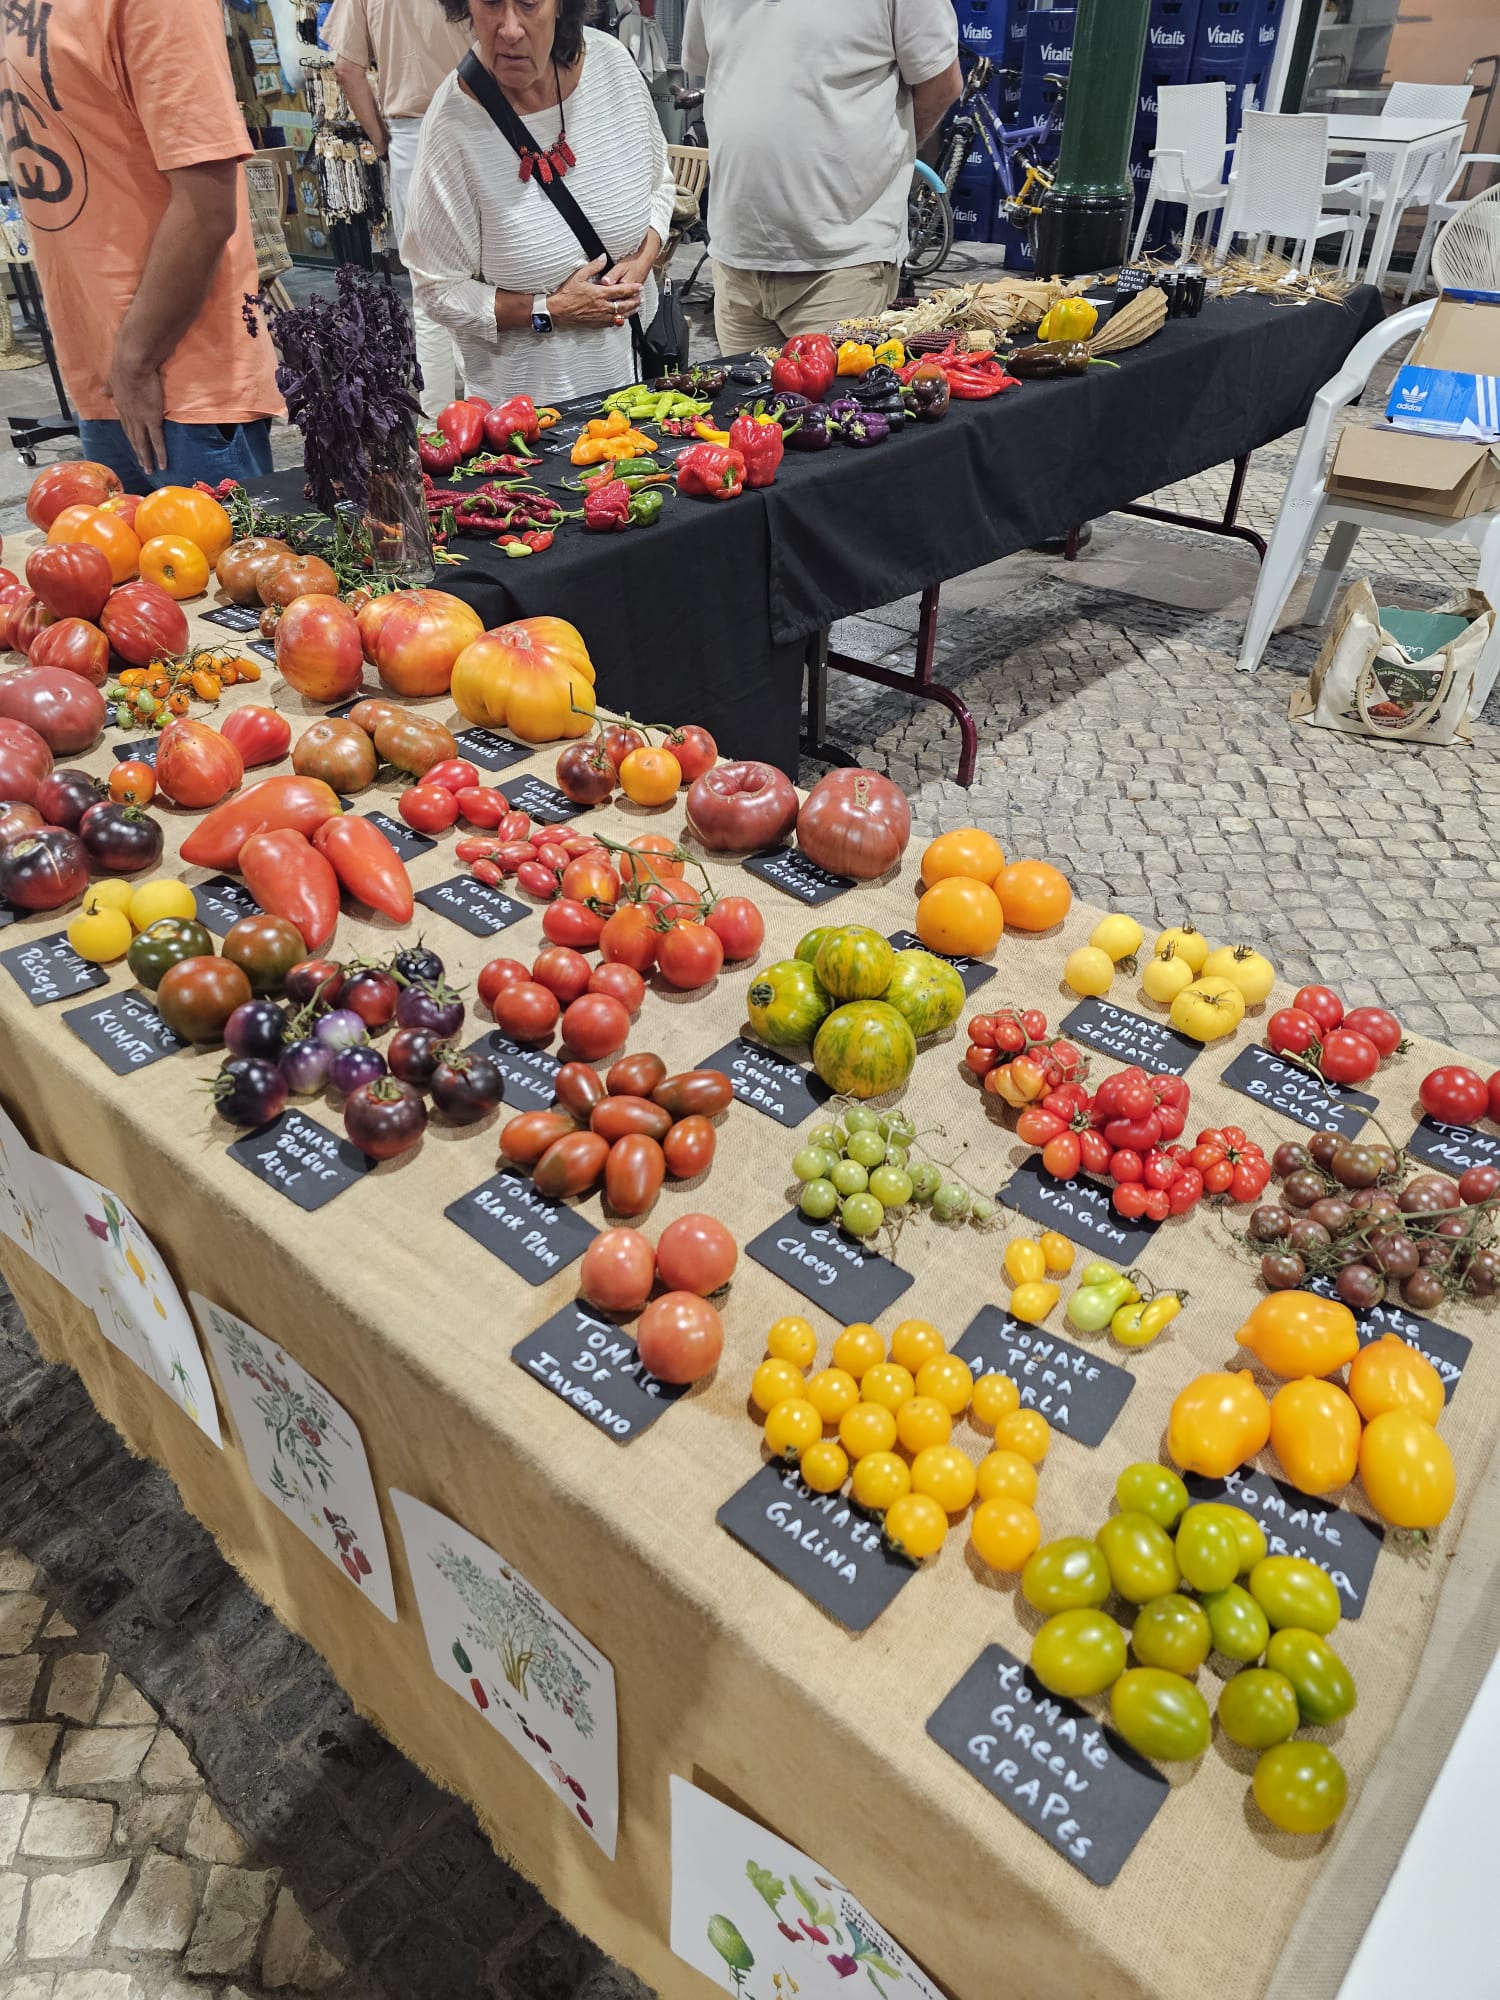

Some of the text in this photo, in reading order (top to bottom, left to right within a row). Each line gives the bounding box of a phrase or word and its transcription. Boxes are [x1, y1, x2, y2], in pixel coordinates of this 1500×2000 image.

[962, 22, 992, 40] Vitalis
[1150, 26, 1185, 45] Vitalis
[1207, 25, 1244, 44] Vitalis
[1396, 402, 1422, 412] adidas
[90, 1009, 154, 1063] KUMATO
[1282, 1083, 1345, 1118] OVAL
[1432, 1121, 1500, 1156] TOM
[572, 1351, 612, 1382] DE
[1008, 1348, 1072, 1395] PERA
[968, 1734, 1092, 1859] GRAPES
